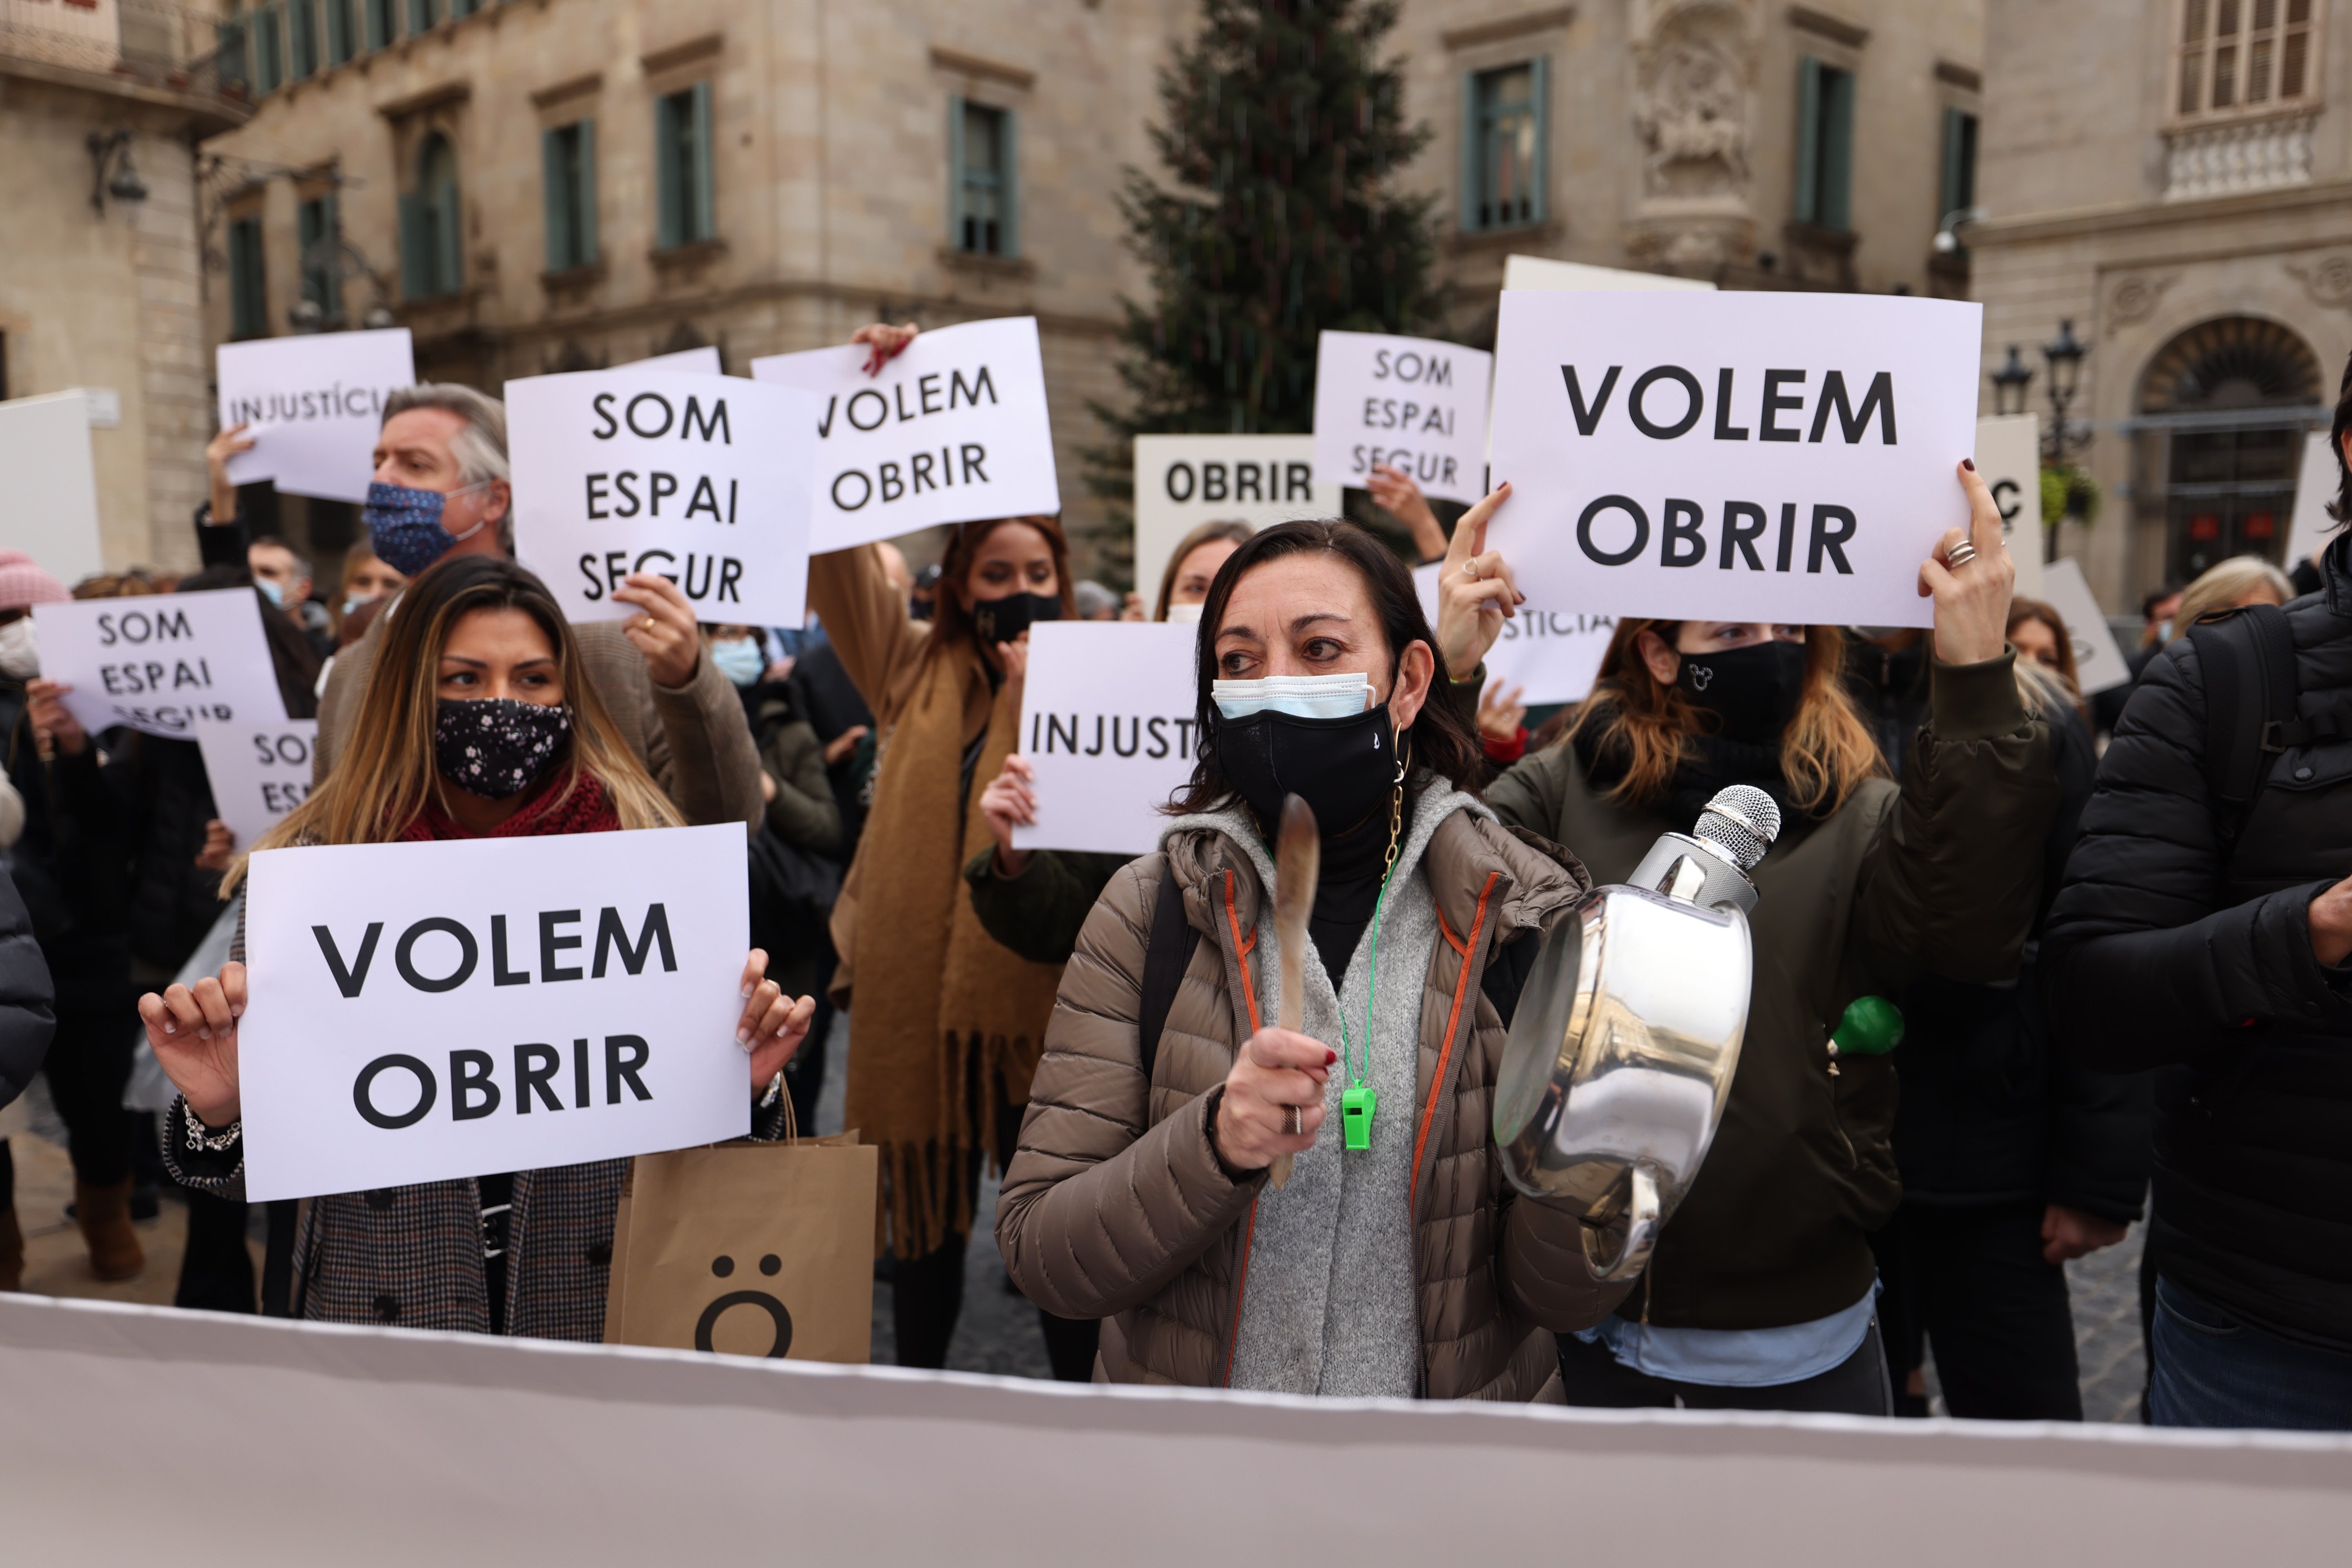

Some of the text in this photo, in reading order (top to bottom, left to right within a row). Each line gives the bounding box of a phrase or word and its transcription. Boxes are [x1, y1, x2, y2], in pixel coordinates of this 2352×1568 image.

[1374, 349, 1452, 386] SOM
[592, 392, 731, 445] SOM
[1363, 398, 1454, 436] ESPAI
[1560, 364, 1898, 446] VOLEM
[585, 470, 738, 524] ESPAI
[831, 443, 989, 511] OBRIR
[1165, 462, 1313, 503] OBRIR
[1576, 494, 1857, 575] OBRIR
[97, 609, 193, 645] SOM
[100, 658, 212, 695] ESPAI
[253, 733, 317, 765] SO
[310, 902, 678, 999] VOLEM
[352, 1034, 654, 1130] OBRIR
